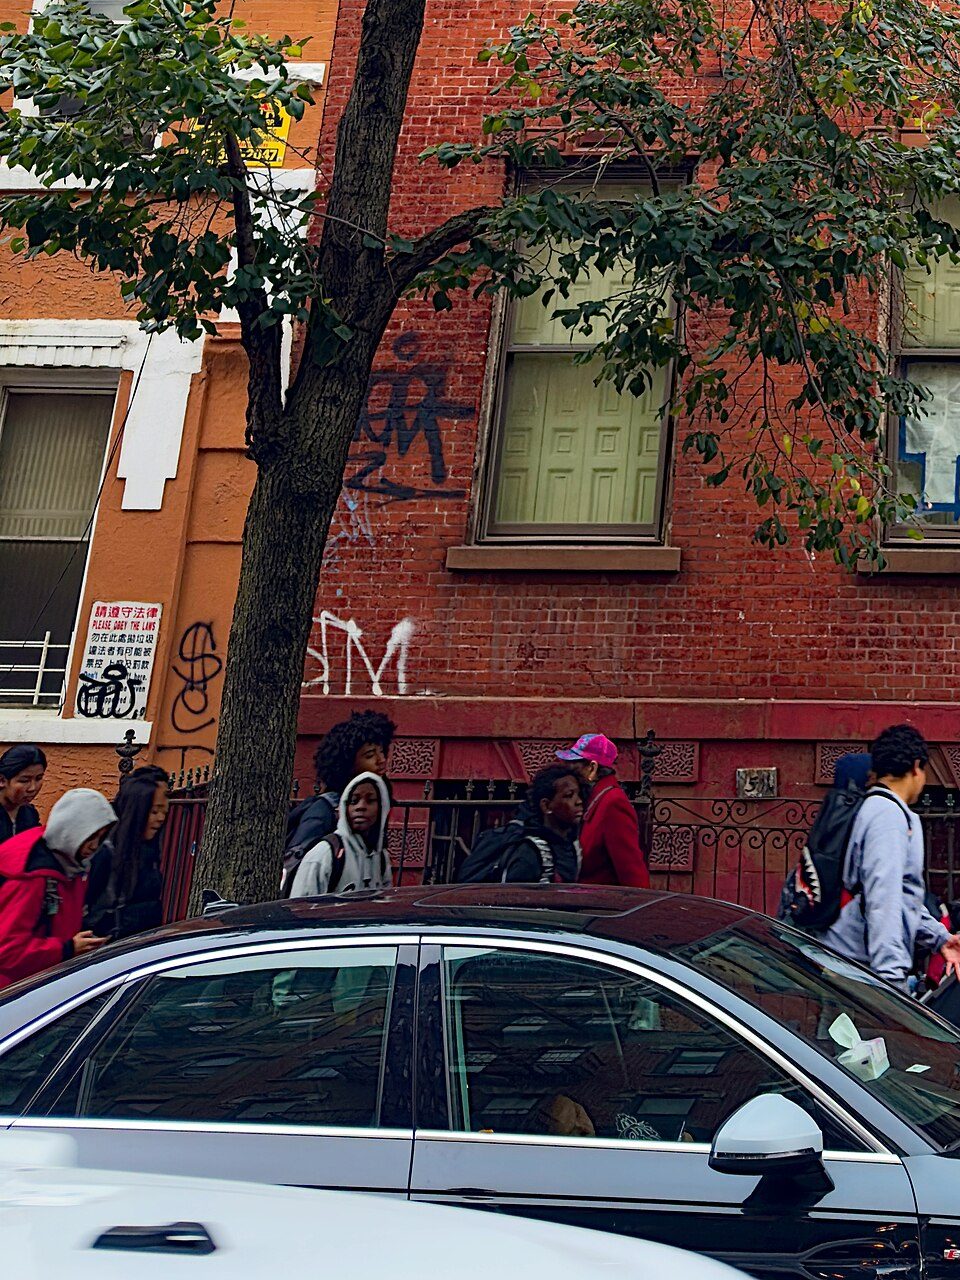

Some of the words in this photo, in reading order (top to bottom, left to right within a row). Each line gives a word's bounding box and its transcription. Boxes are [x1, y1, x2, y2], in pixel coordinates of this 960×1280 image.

[95, 606, 158, 618] 請遵守法律
[92, 620, 111, 630] PLEASE
[114, 621, 127, 630] OBEY
[131, 621, 140, 630] THE
[142, 622, 156, 631] LAWS
